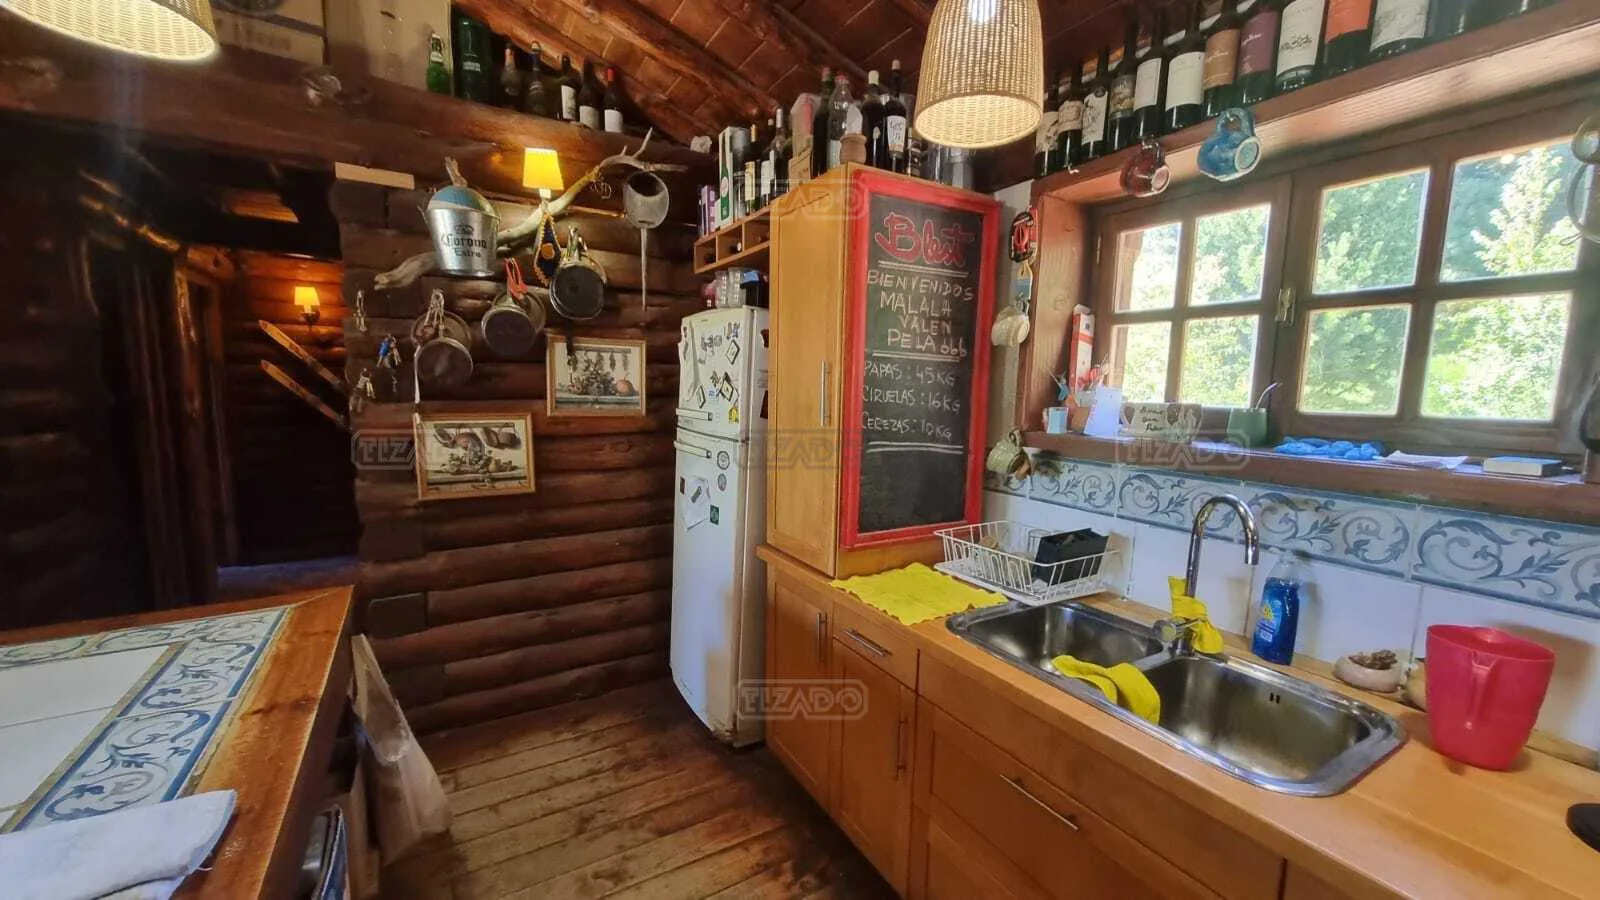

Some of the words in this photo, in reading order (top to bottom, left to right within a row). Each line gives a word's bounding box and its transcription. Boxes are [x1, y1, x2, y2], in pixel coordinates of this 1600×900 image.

[441, 233, 487, 248] Corona
[867, 269, 974, 301] BIENVENIDOS
[899, 315, 952, 336] VALEN
